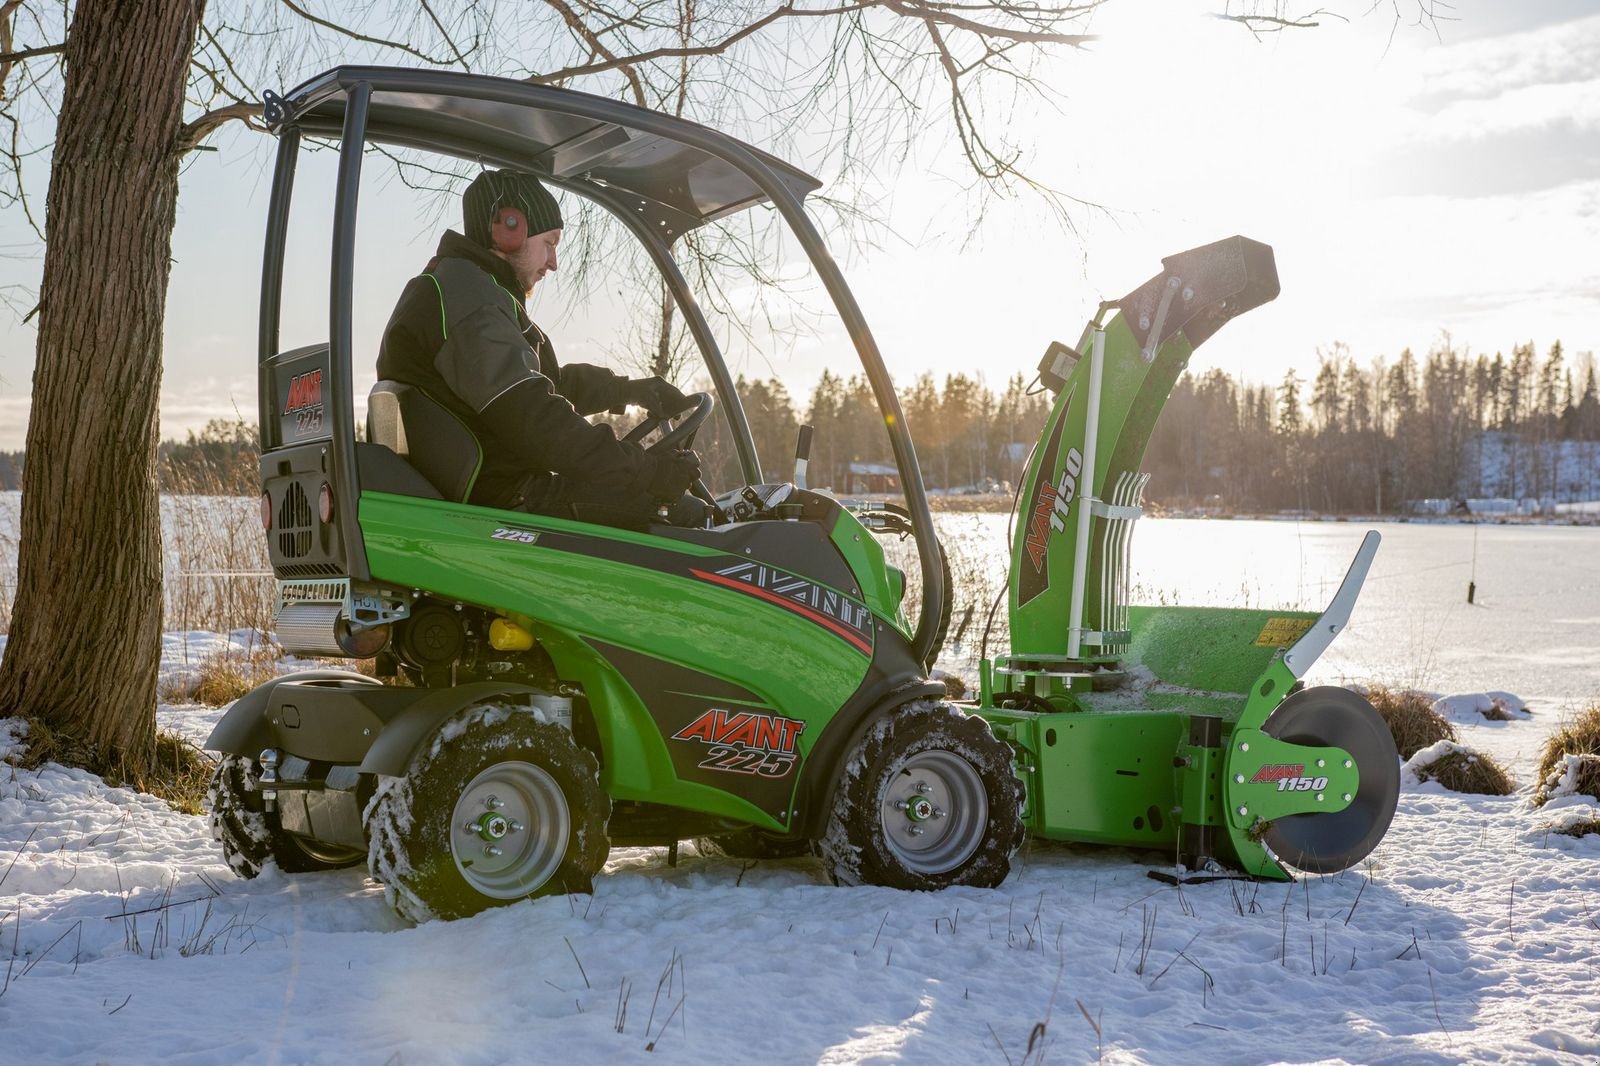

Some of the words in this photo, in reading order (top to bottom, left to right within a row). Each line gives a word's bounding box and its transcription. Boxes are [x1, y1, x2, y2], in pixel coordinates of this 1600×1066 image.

[284, 369, 323, 414] AVANT
[295, 406, 324, 436] 225
[1049, 447, 1084, 533] 1150
[490, 527, 537, 545] 225
[1025, 481, 1058, 574] AVANT
[715, 562, 869, 629] AVANT
[671, 708, 805, 753] AVANT
[698, 746, 796, 777] 225
[1249, 764, 1304, 784] AVANT
[1277, 776, 1328, 792] 1150
